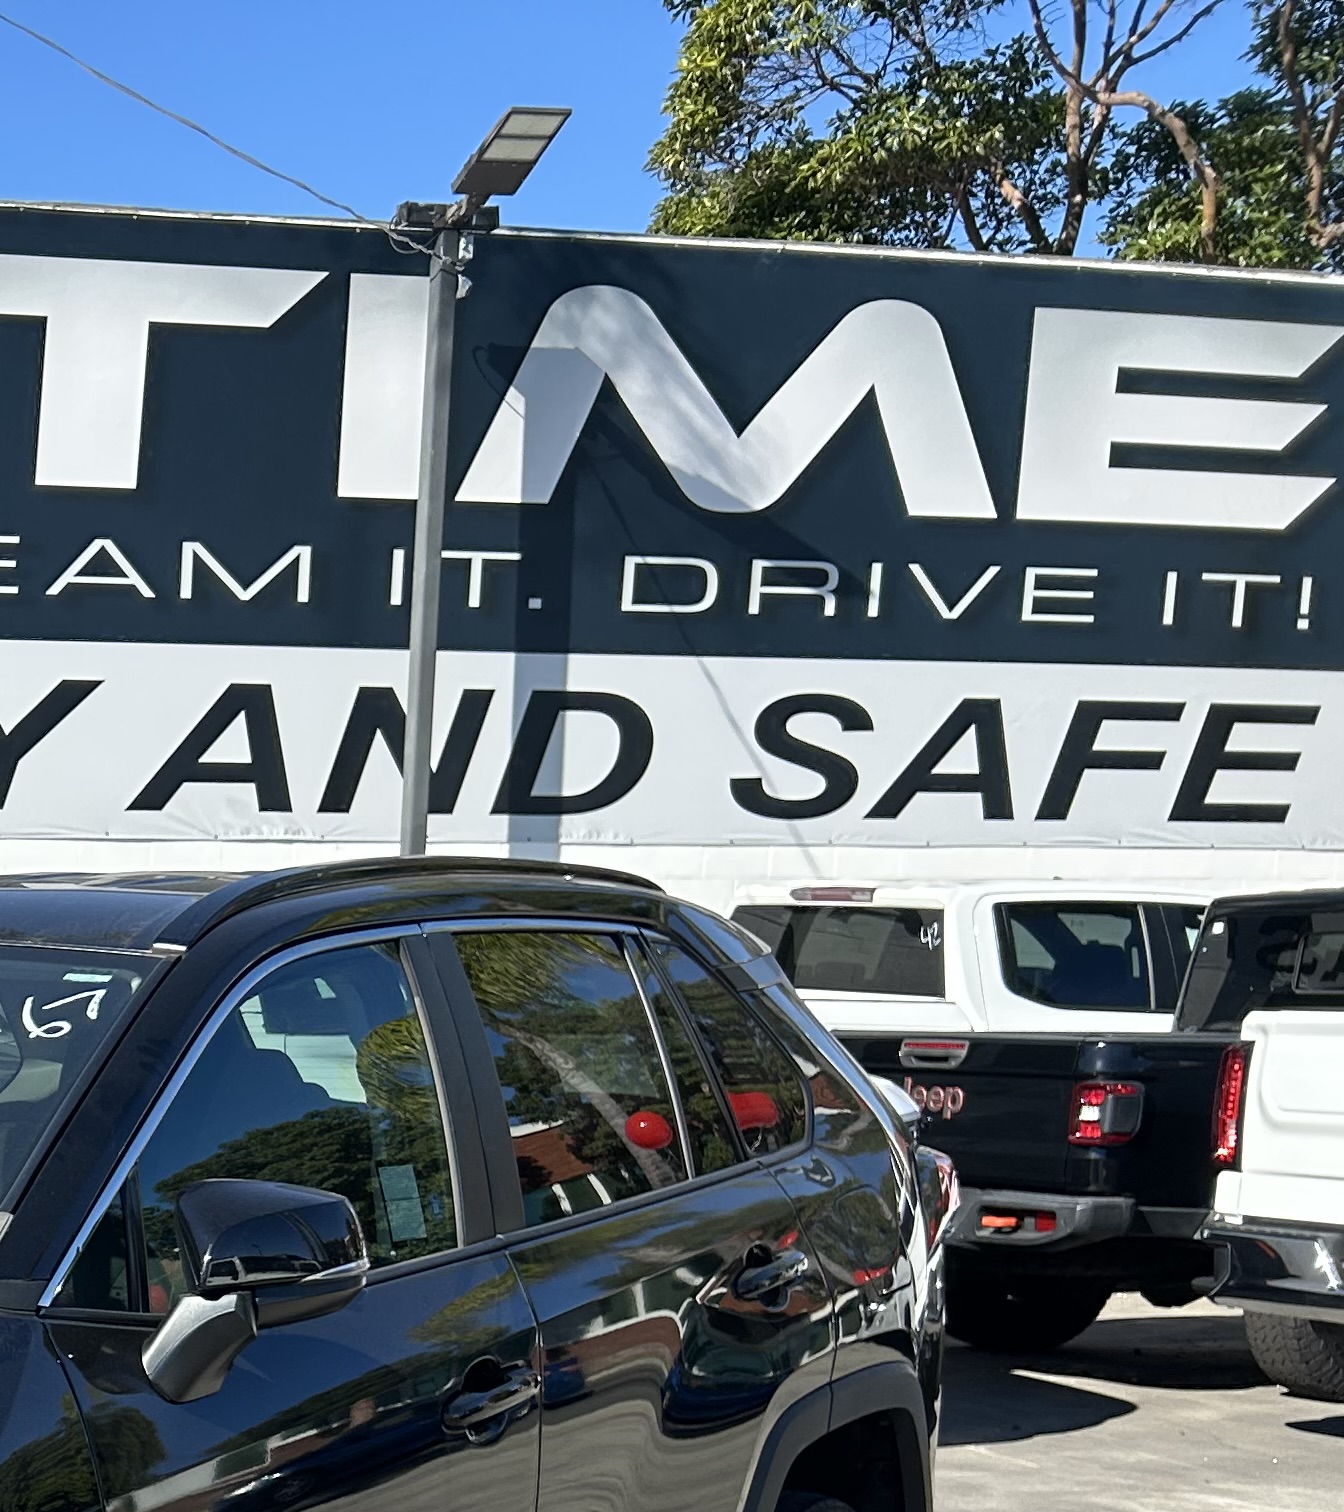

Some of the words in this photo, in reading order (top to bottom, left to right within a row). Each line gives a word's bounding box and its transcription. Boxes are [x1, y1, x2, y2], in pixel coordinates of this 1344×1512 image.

[389, 548, 542, 610] IT.
[620, 554, 1099, 622] DRIVE
[1162, 569, 1313, 631] IT!
[129, 683, 655, 816] AND
[729, 692, 1322, 824] SAFE
[22, 988, 108, 1039] 67
